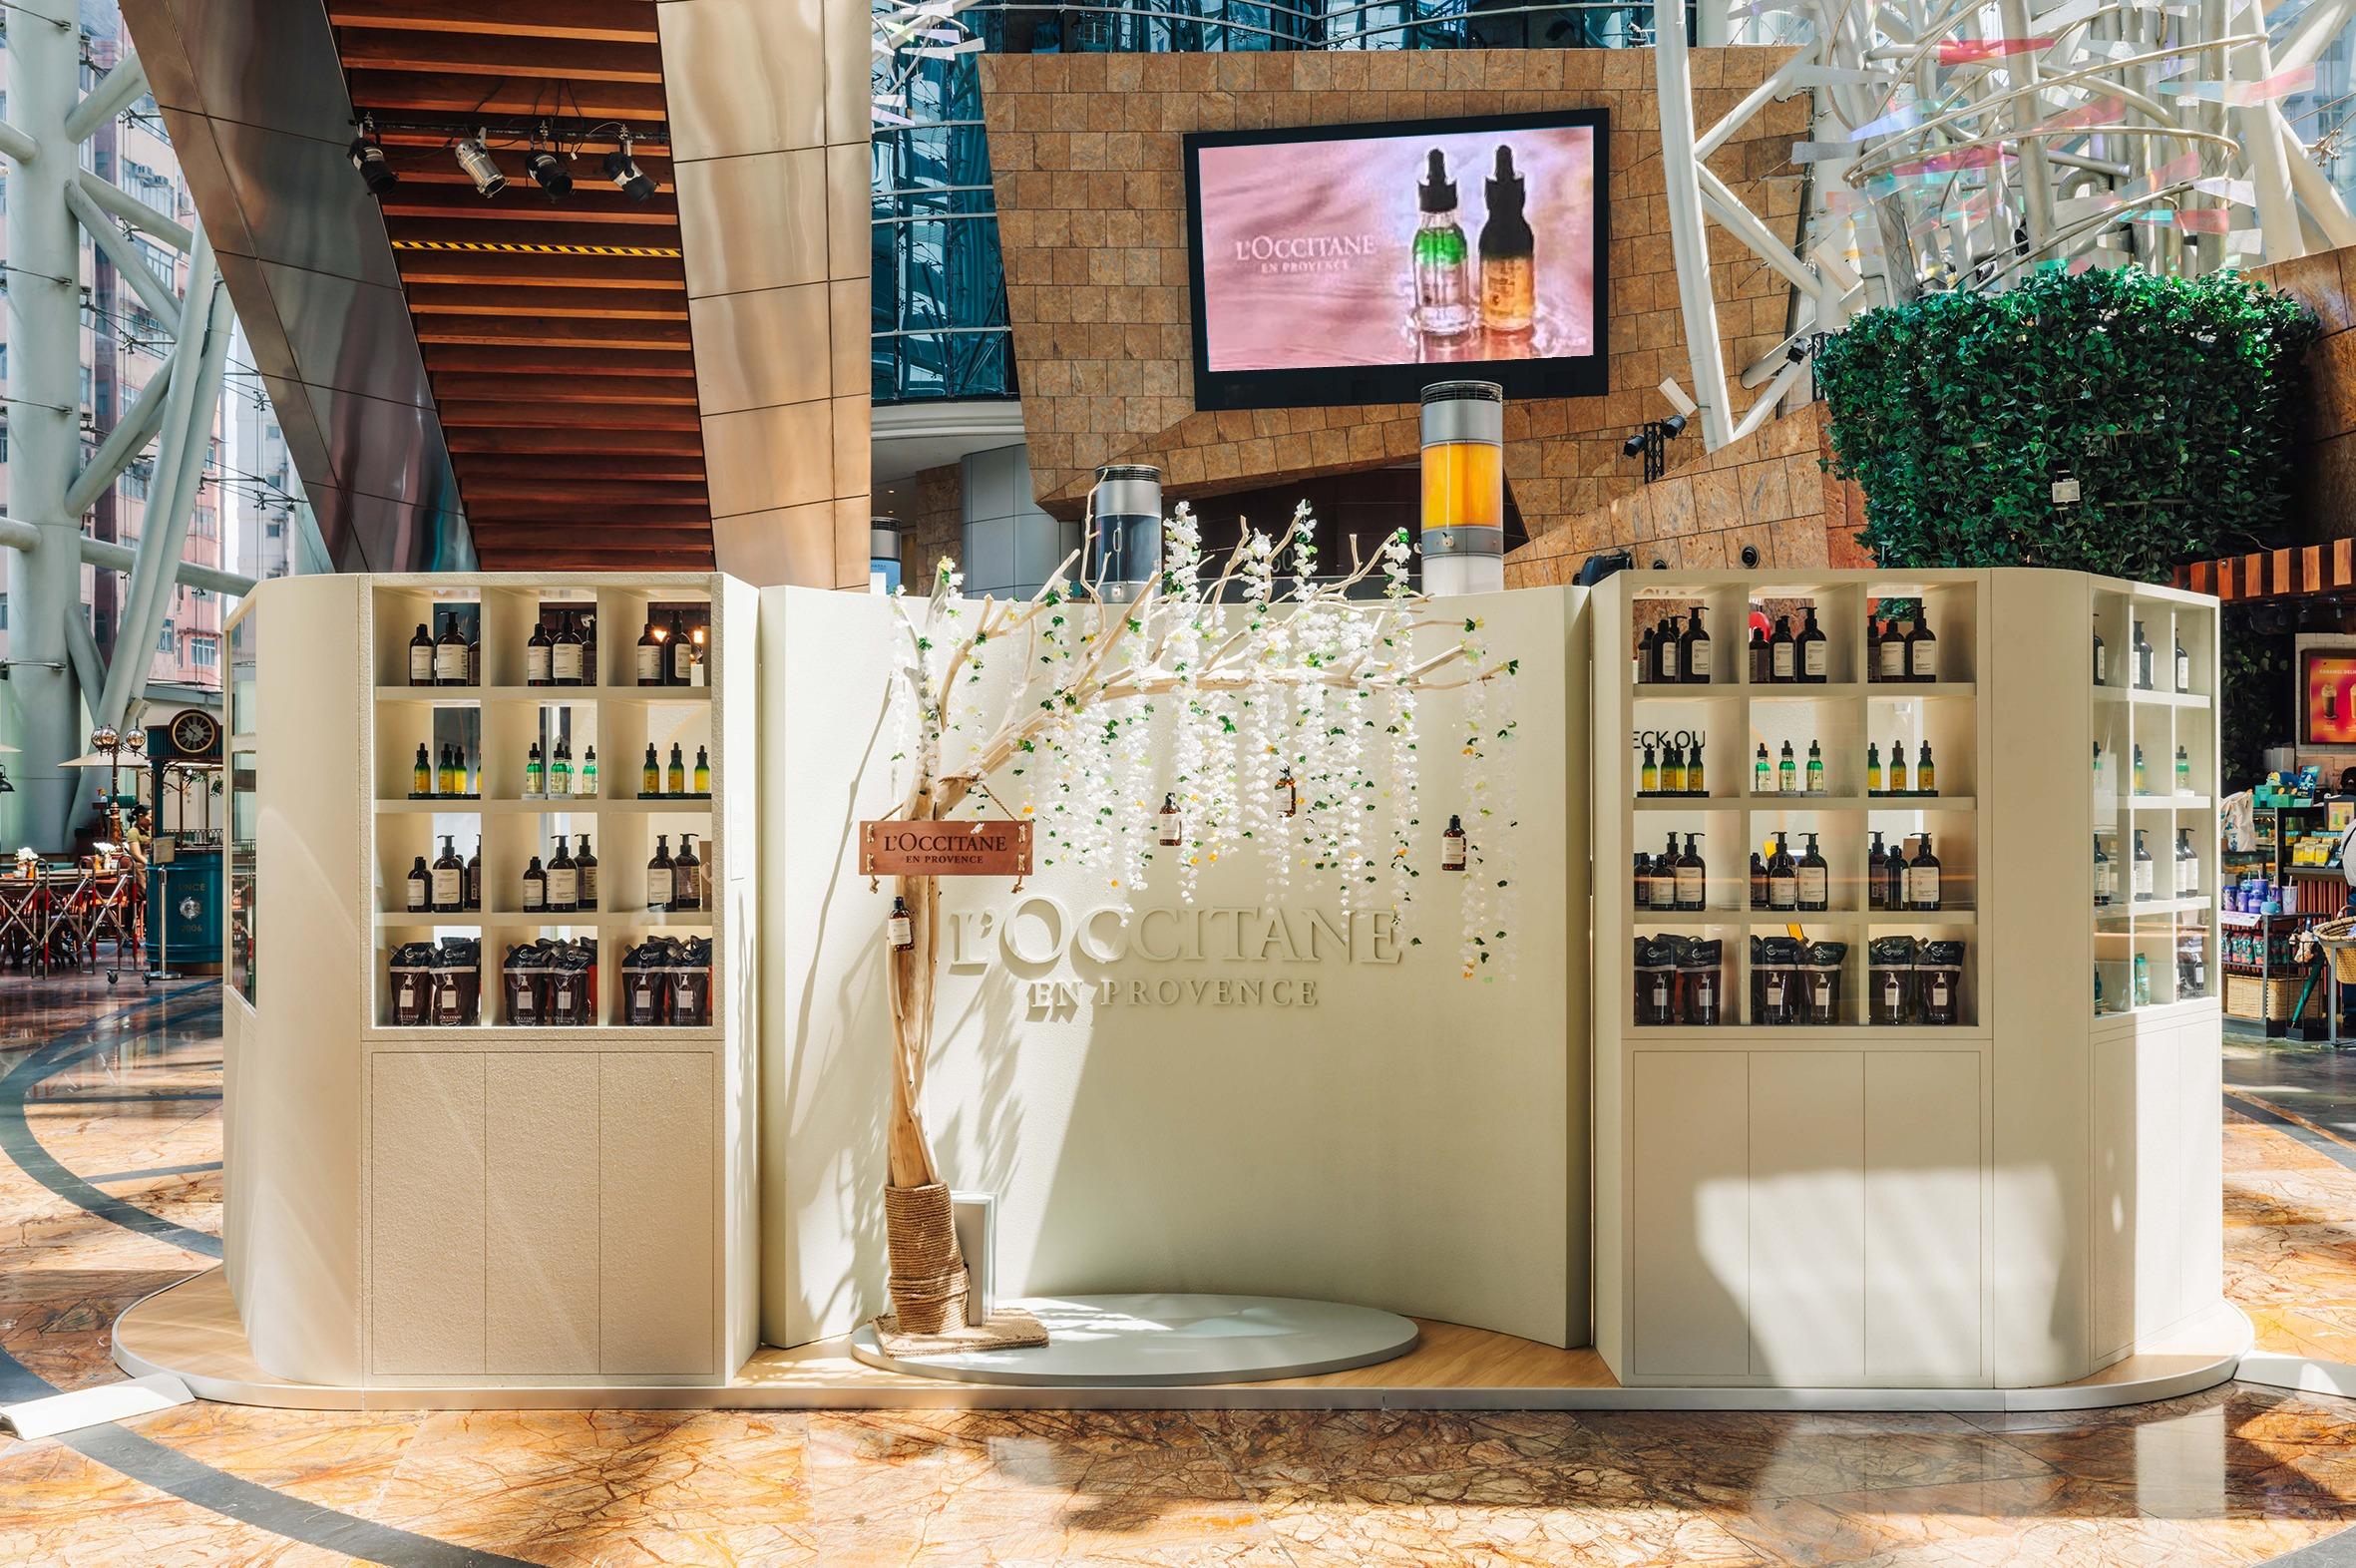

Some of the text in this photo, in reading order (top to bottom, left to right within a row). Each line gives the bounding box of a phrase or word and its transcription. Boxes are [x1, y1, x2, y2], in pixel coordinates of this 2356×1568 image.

[1236, 234, 1376, 261] L'OCCITANE
[884, 832, 1007, 852] L'OCCITANE
[906, 855, 983, 864] EN PROVENCE
[951, 896, 1403, 965] L'OCCITANE
[1029, 980, 1319, 1007] EN PROVENCE
